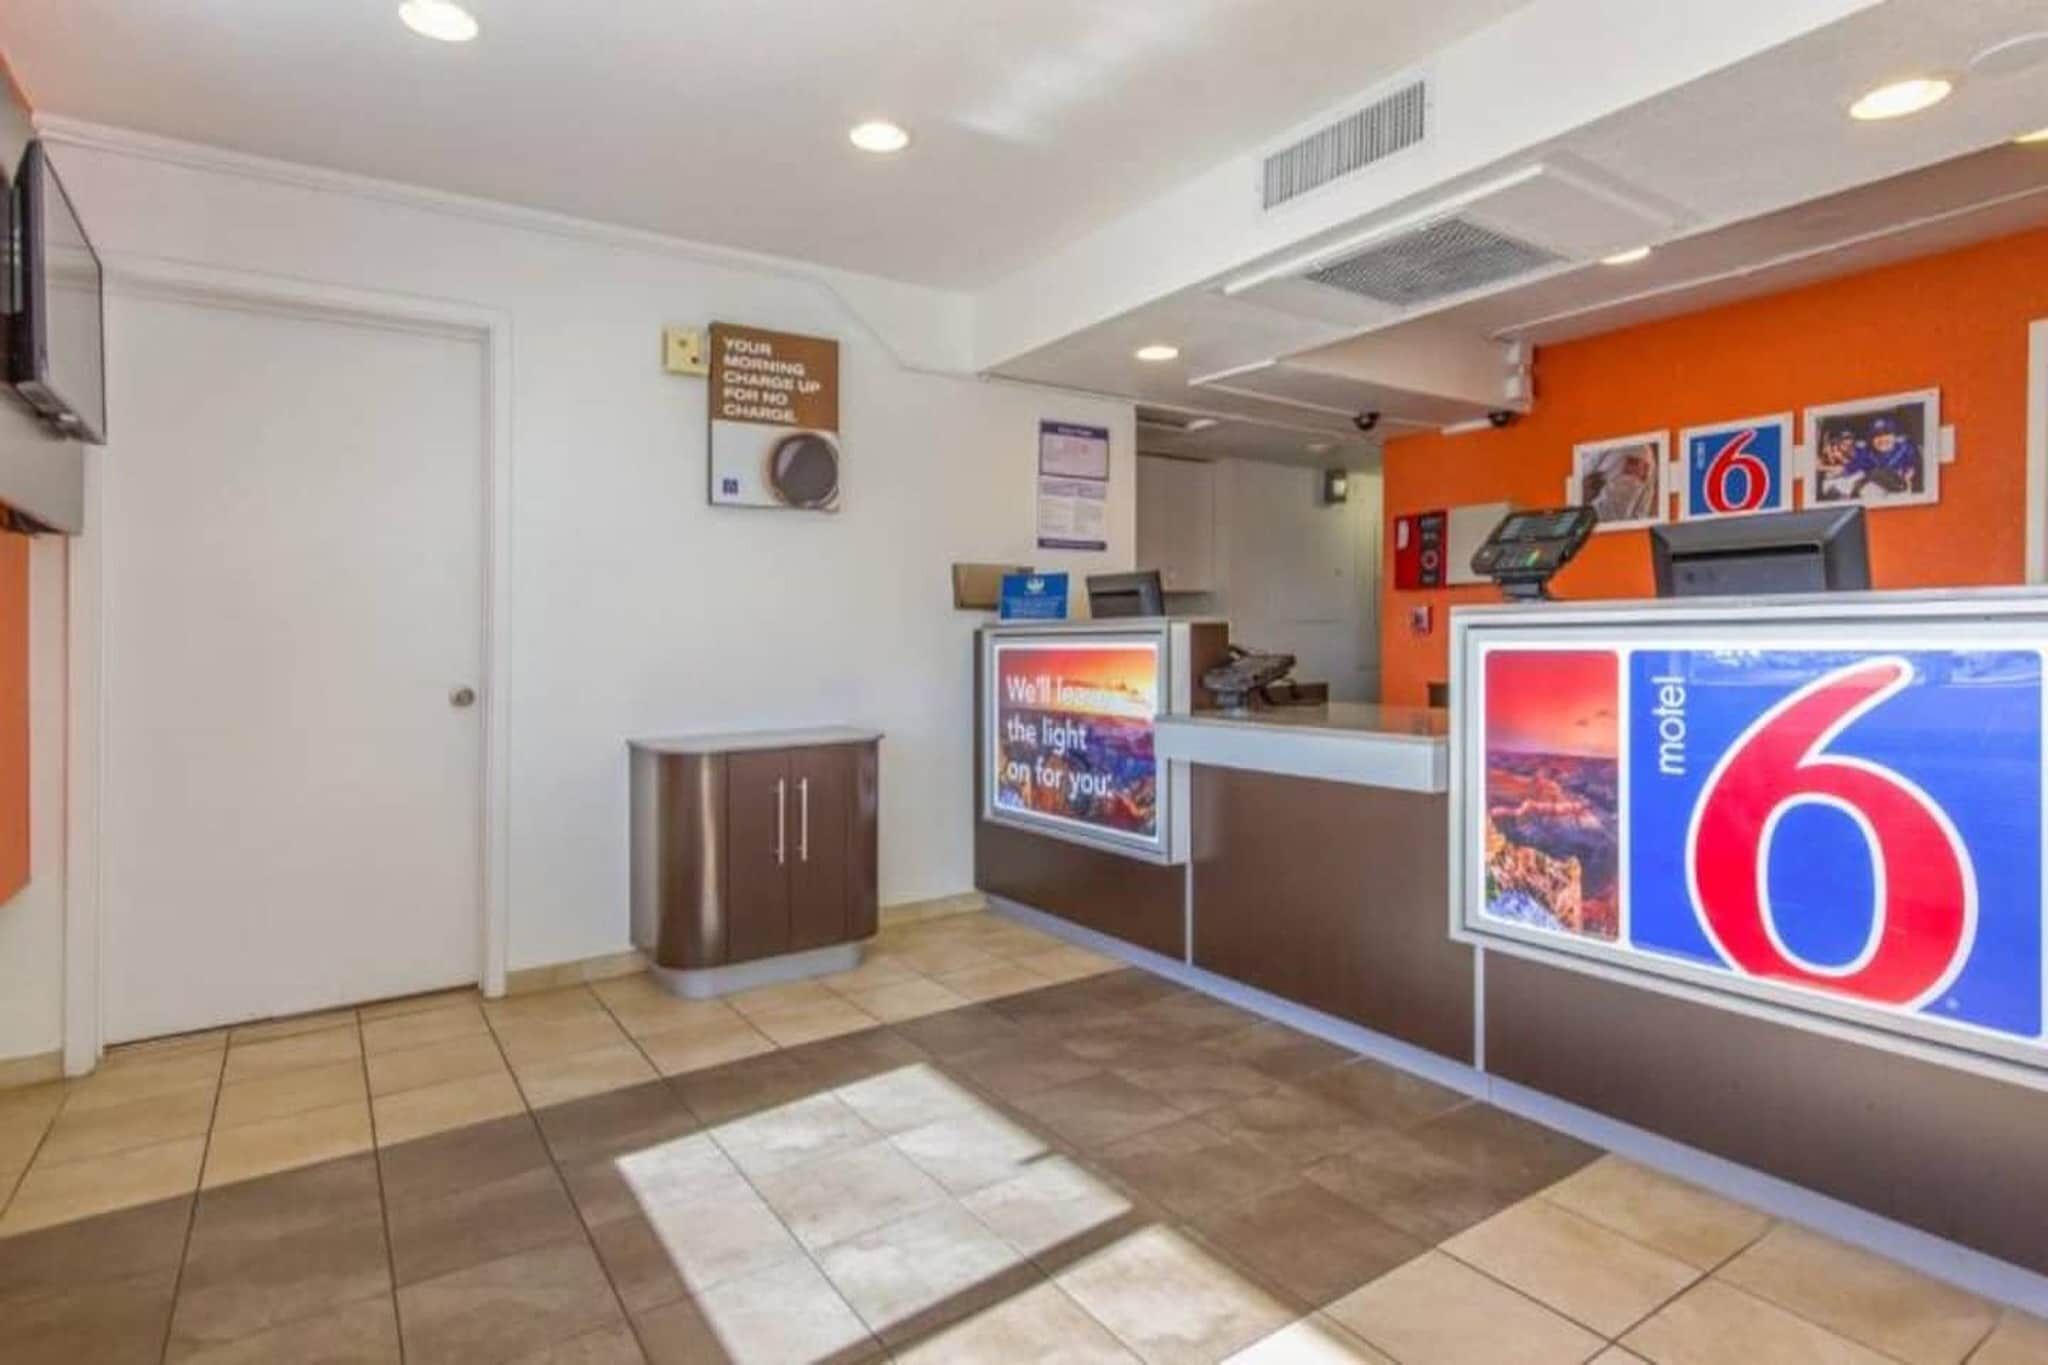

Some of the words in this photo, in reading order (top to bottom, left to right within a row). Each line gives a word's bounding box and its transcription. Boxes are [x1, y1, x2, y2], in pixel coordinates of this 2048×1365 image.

[724, 339, 771, 355] YOUR
[724, 355, 804, 375] MORNING
[724, 371, 794, 391] CHARGE
[799, 380, 820, 393] UP
[724, 387, 759, 401] FOR
[763, 392, 788, 405] NO
[1703, 428, 1770, 514] 6
[1006, 674, 1050, 702] We'll
[1007, 714, 1037, 743] the
[1042, 716, 1088, 754] light
[1006, 760, 1031, 785] on
[1035, 756, 1062, 789] for
[1652, 675, 1685, 776] motel
[1685, 655, 1979, 1012] 6
